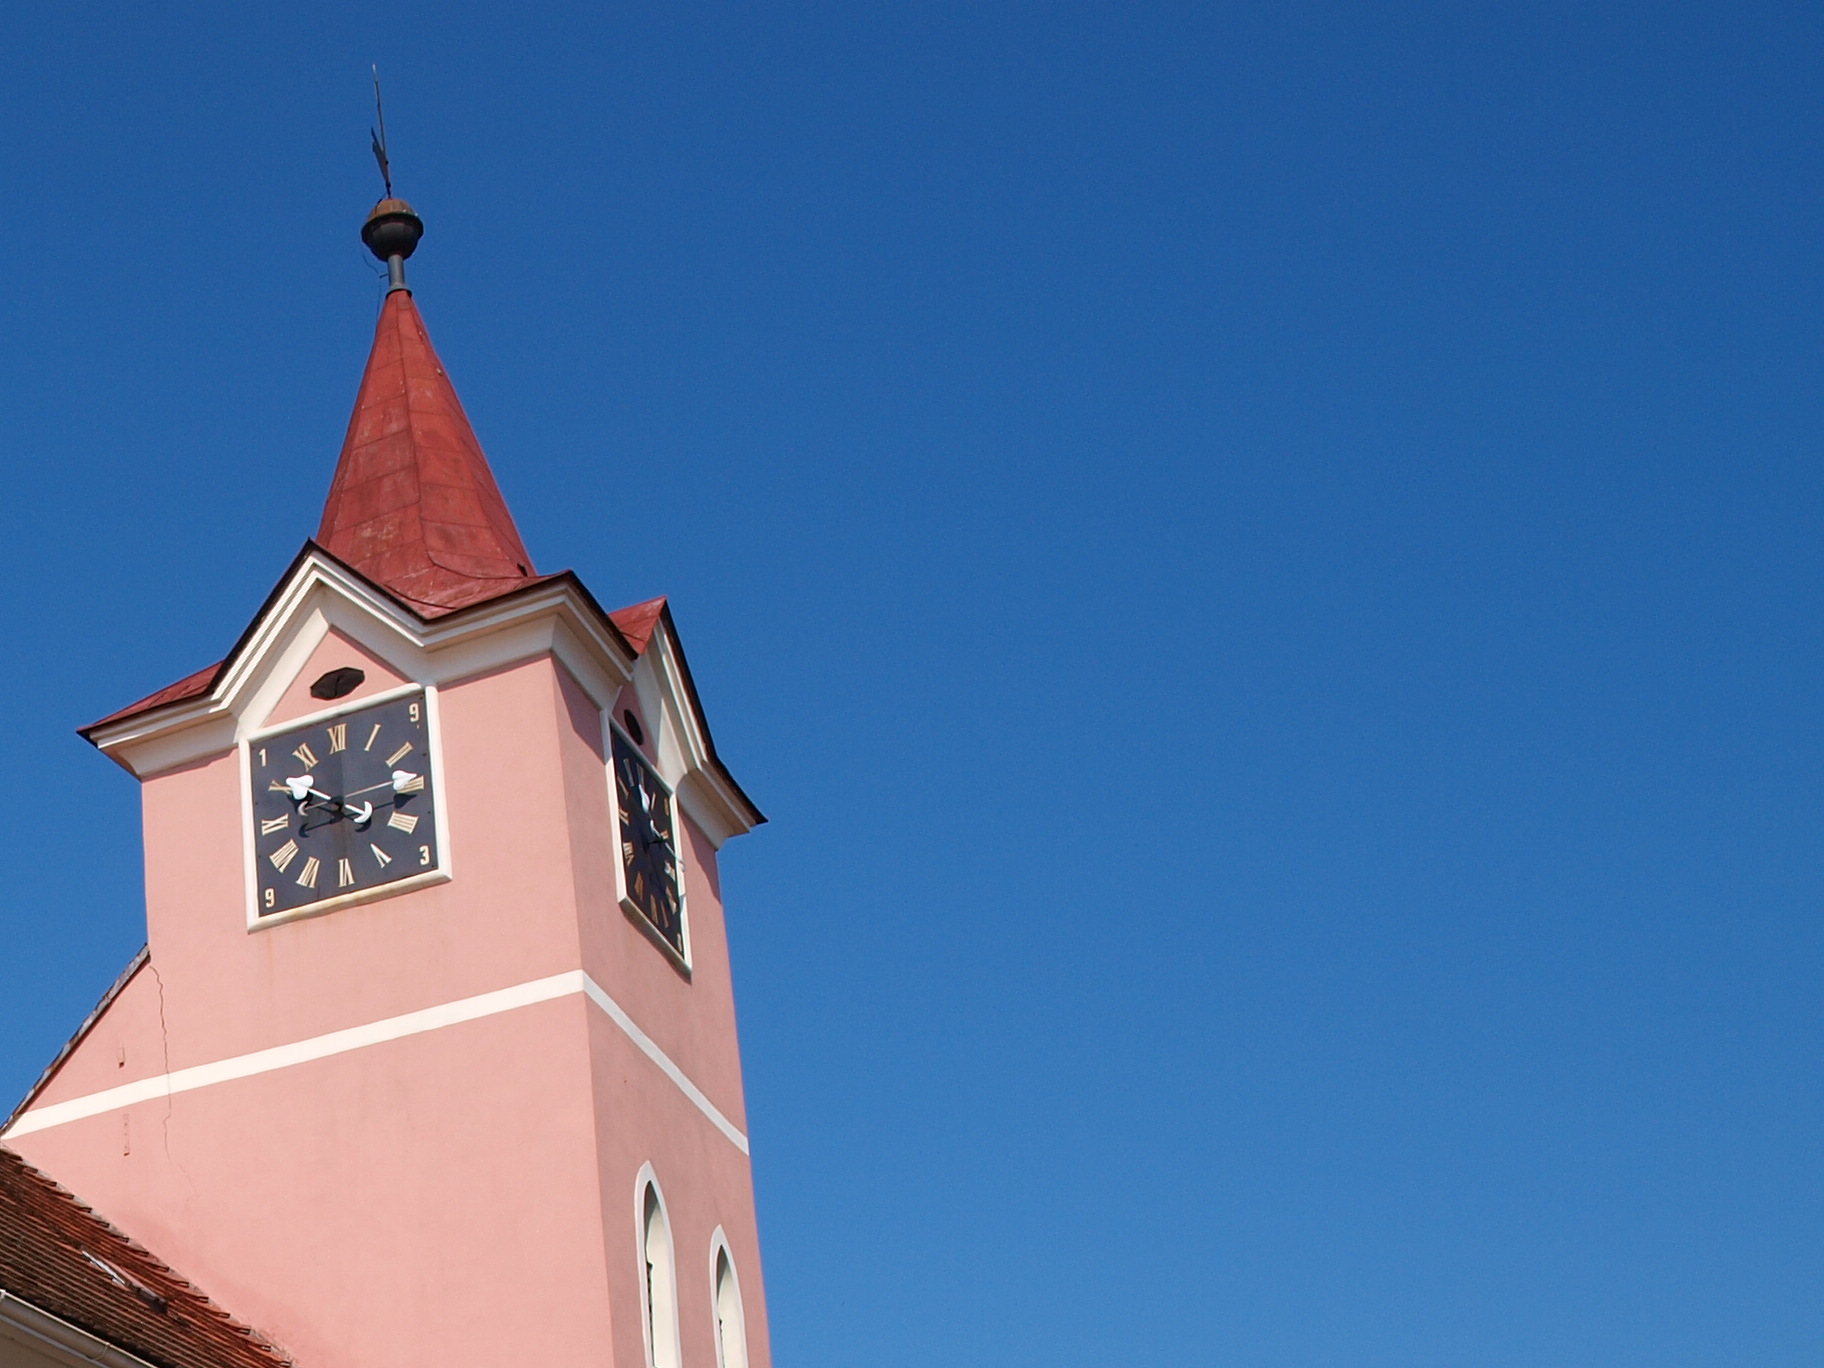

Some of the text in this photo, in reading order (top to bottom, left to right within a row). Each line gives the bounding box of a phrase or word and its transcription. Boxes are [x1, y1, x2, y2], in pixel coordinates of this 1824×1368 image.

[409, 703, 419, 722] 9
[258, 747, 267, 768] 1
[419, 845, 431, 865] 3
[264, 888, 275, 908] 9
